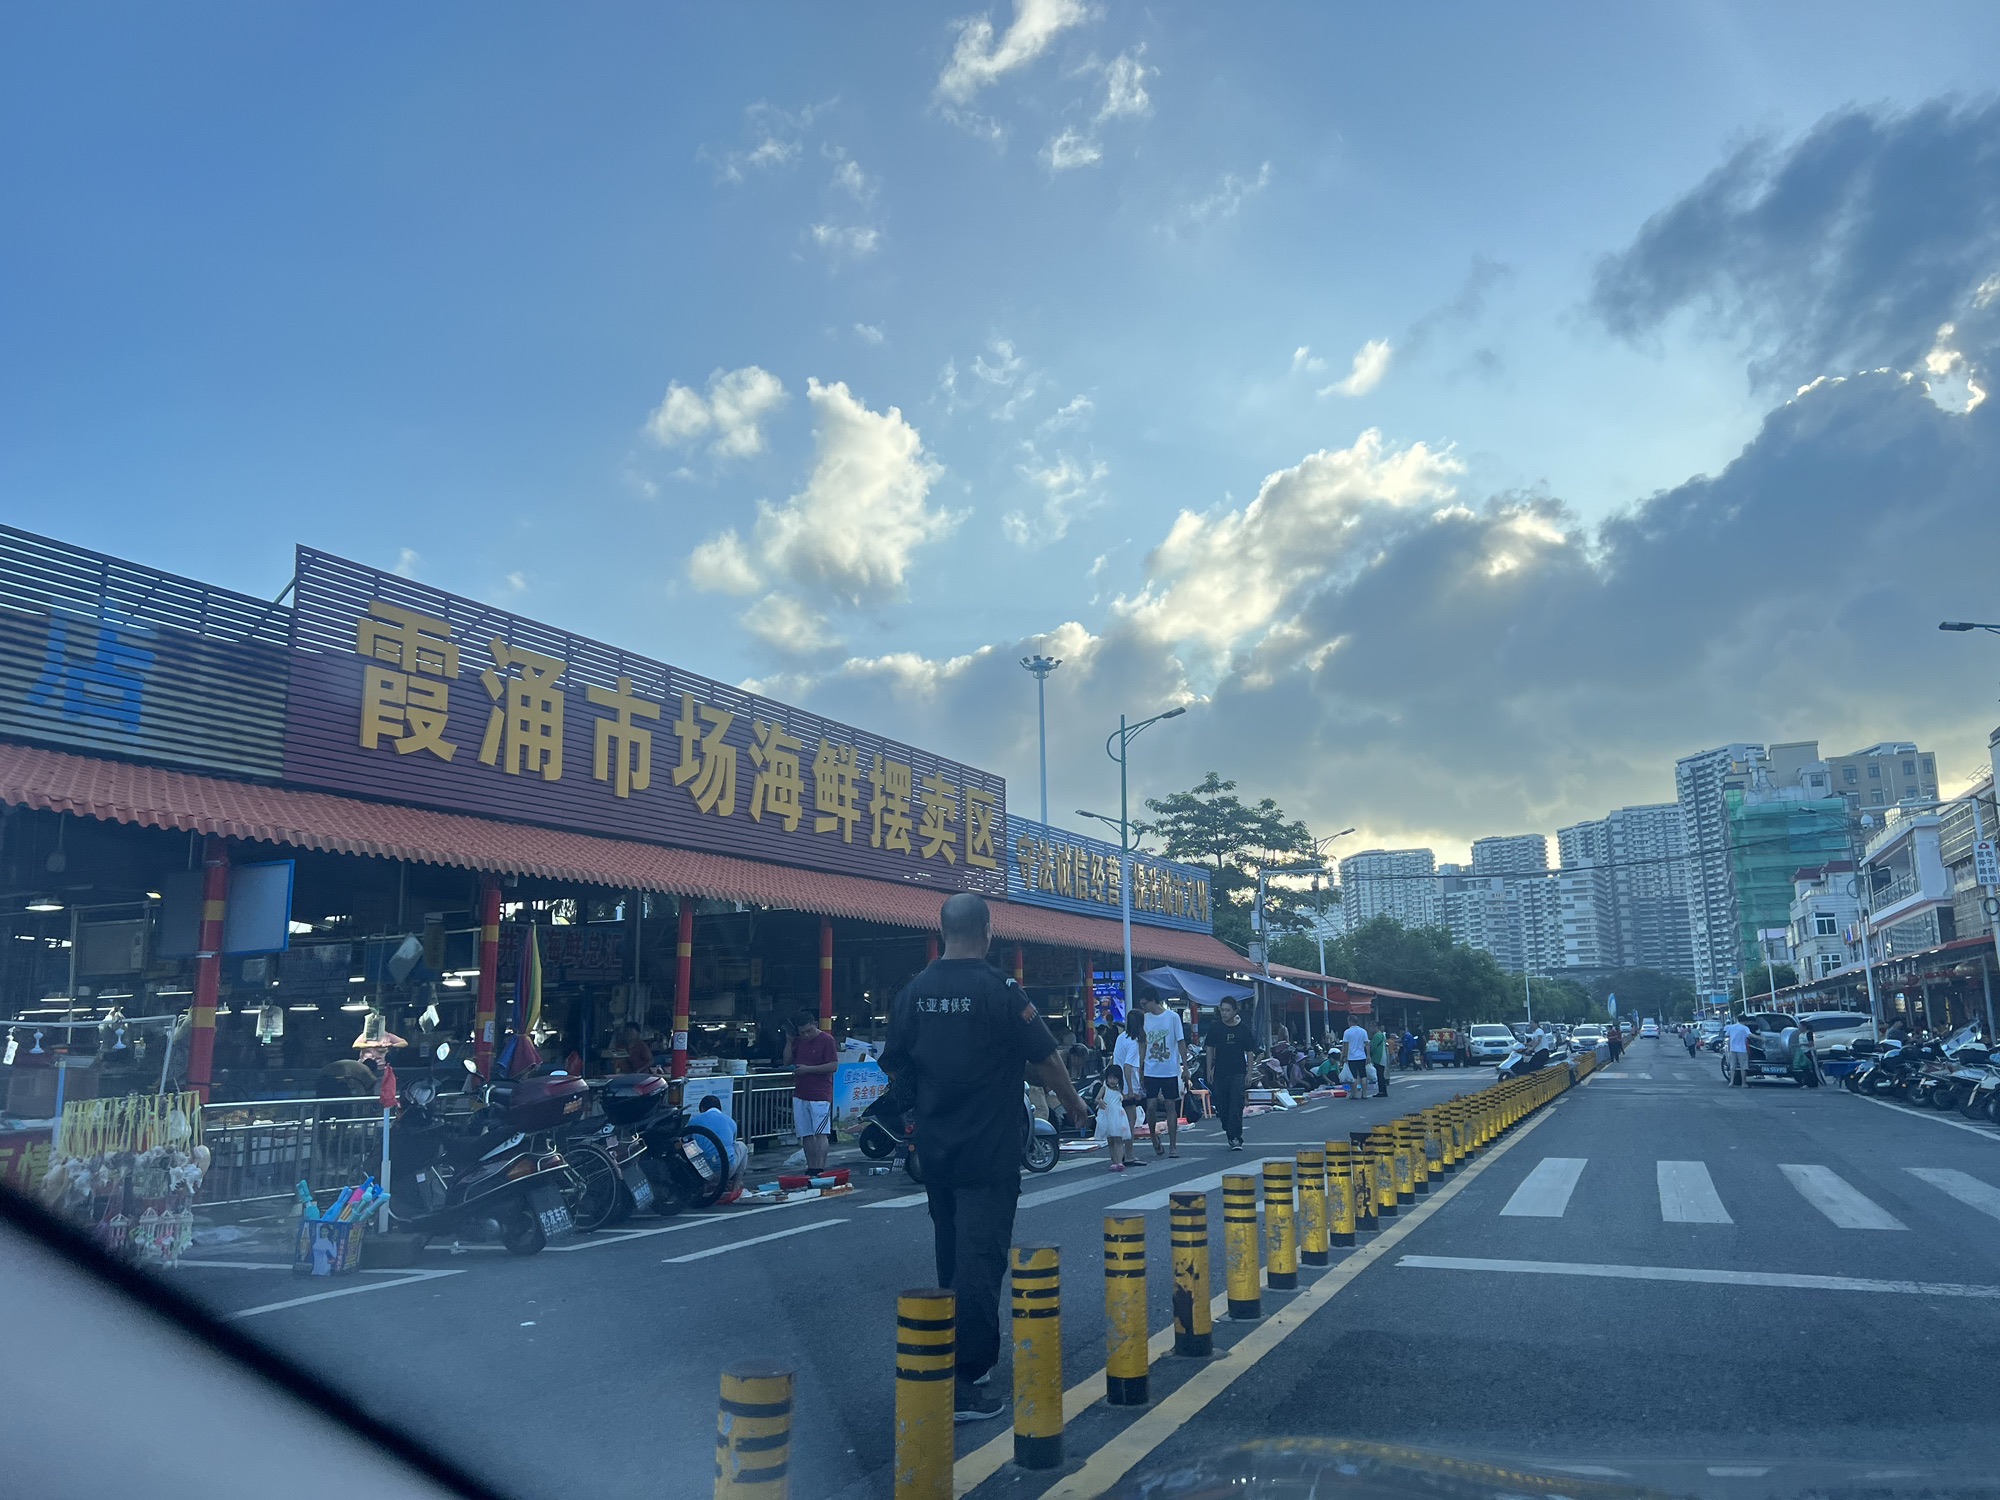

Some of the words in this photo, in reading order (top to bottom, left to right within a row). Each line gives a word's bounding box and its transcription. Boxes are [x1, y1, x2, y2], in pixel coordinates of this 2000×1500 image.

[355, 600, 997, 870] 霞涌市场海鲜摆卖区
[1016, 832, 1121, 906] 守法诚信经营
[916, 996, 972, 1014] 大亚湾保安
